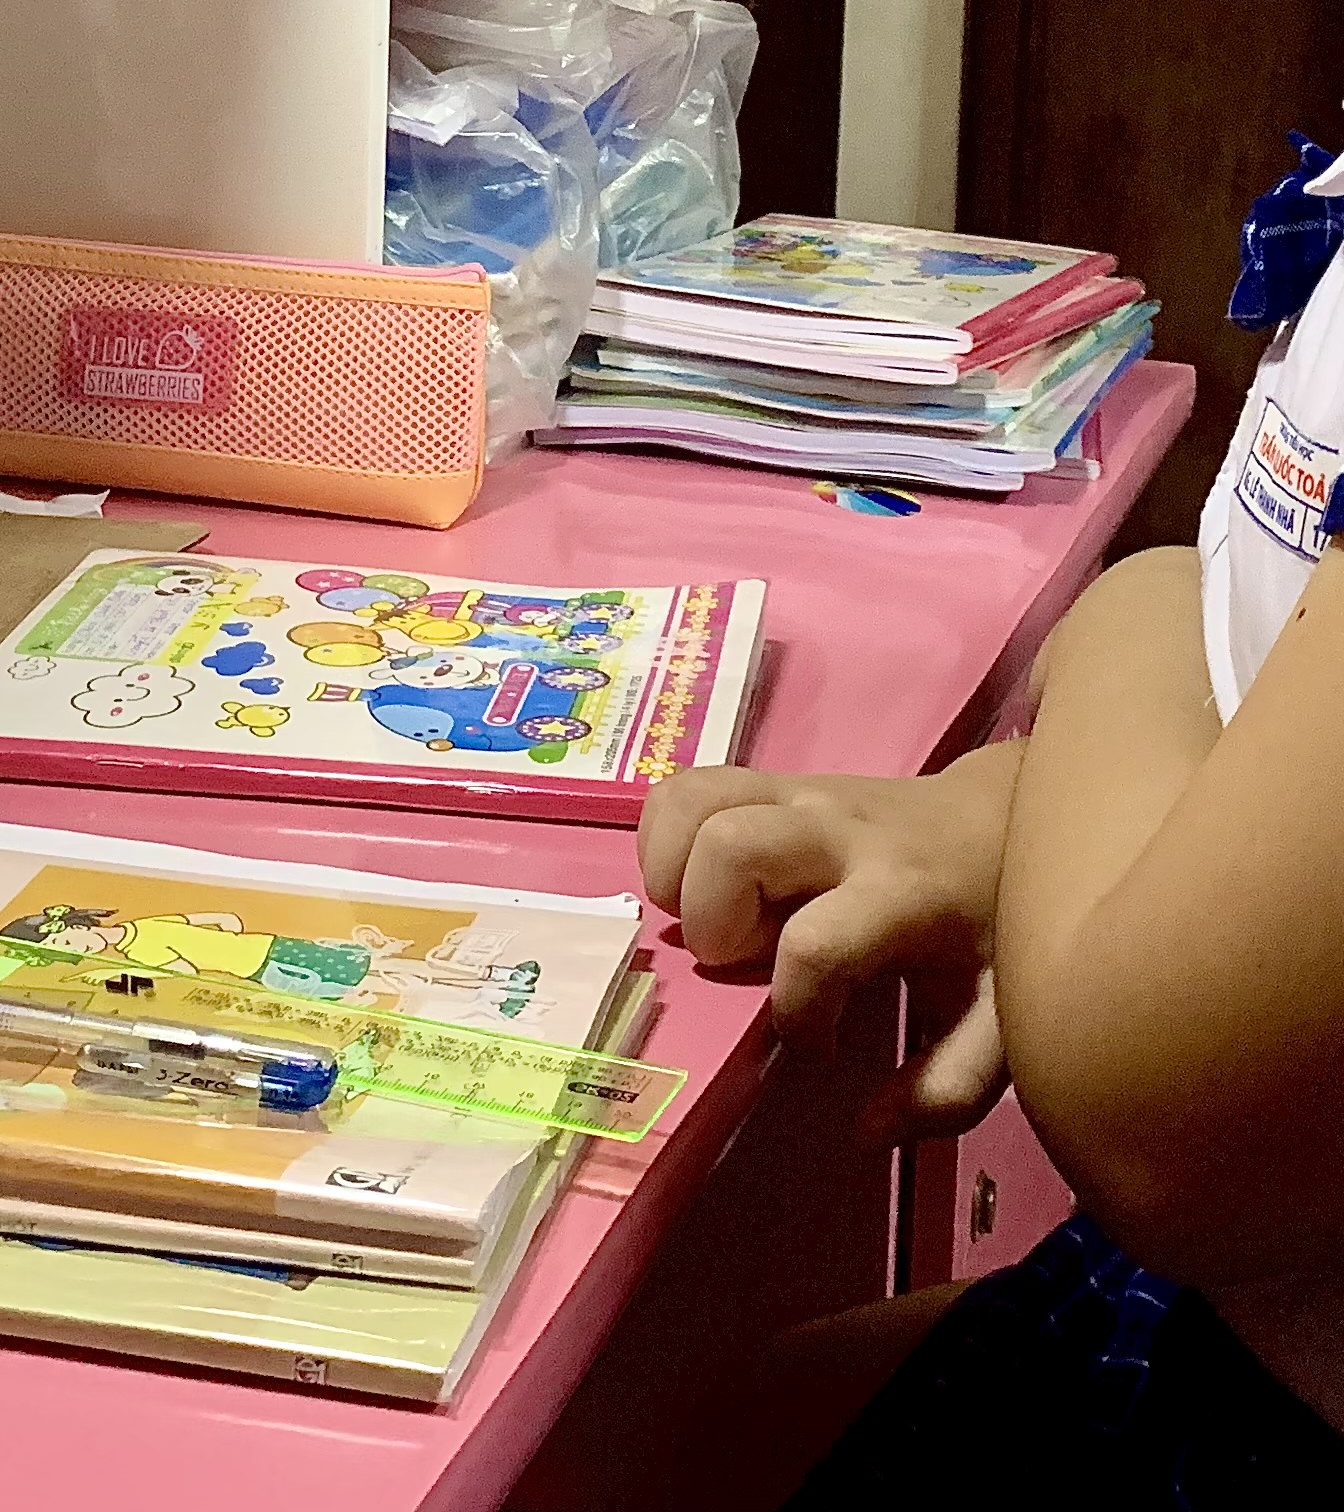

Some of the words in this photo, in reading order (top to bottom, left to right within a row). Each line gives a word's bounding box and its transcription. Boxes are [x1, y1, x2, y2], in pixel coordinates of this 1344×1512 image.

[101, 336, 150, 367] LOVE
[86, 369, 202, 402] STRAWBERRIES
[1296, 468, 1327, 505] TOẢ
